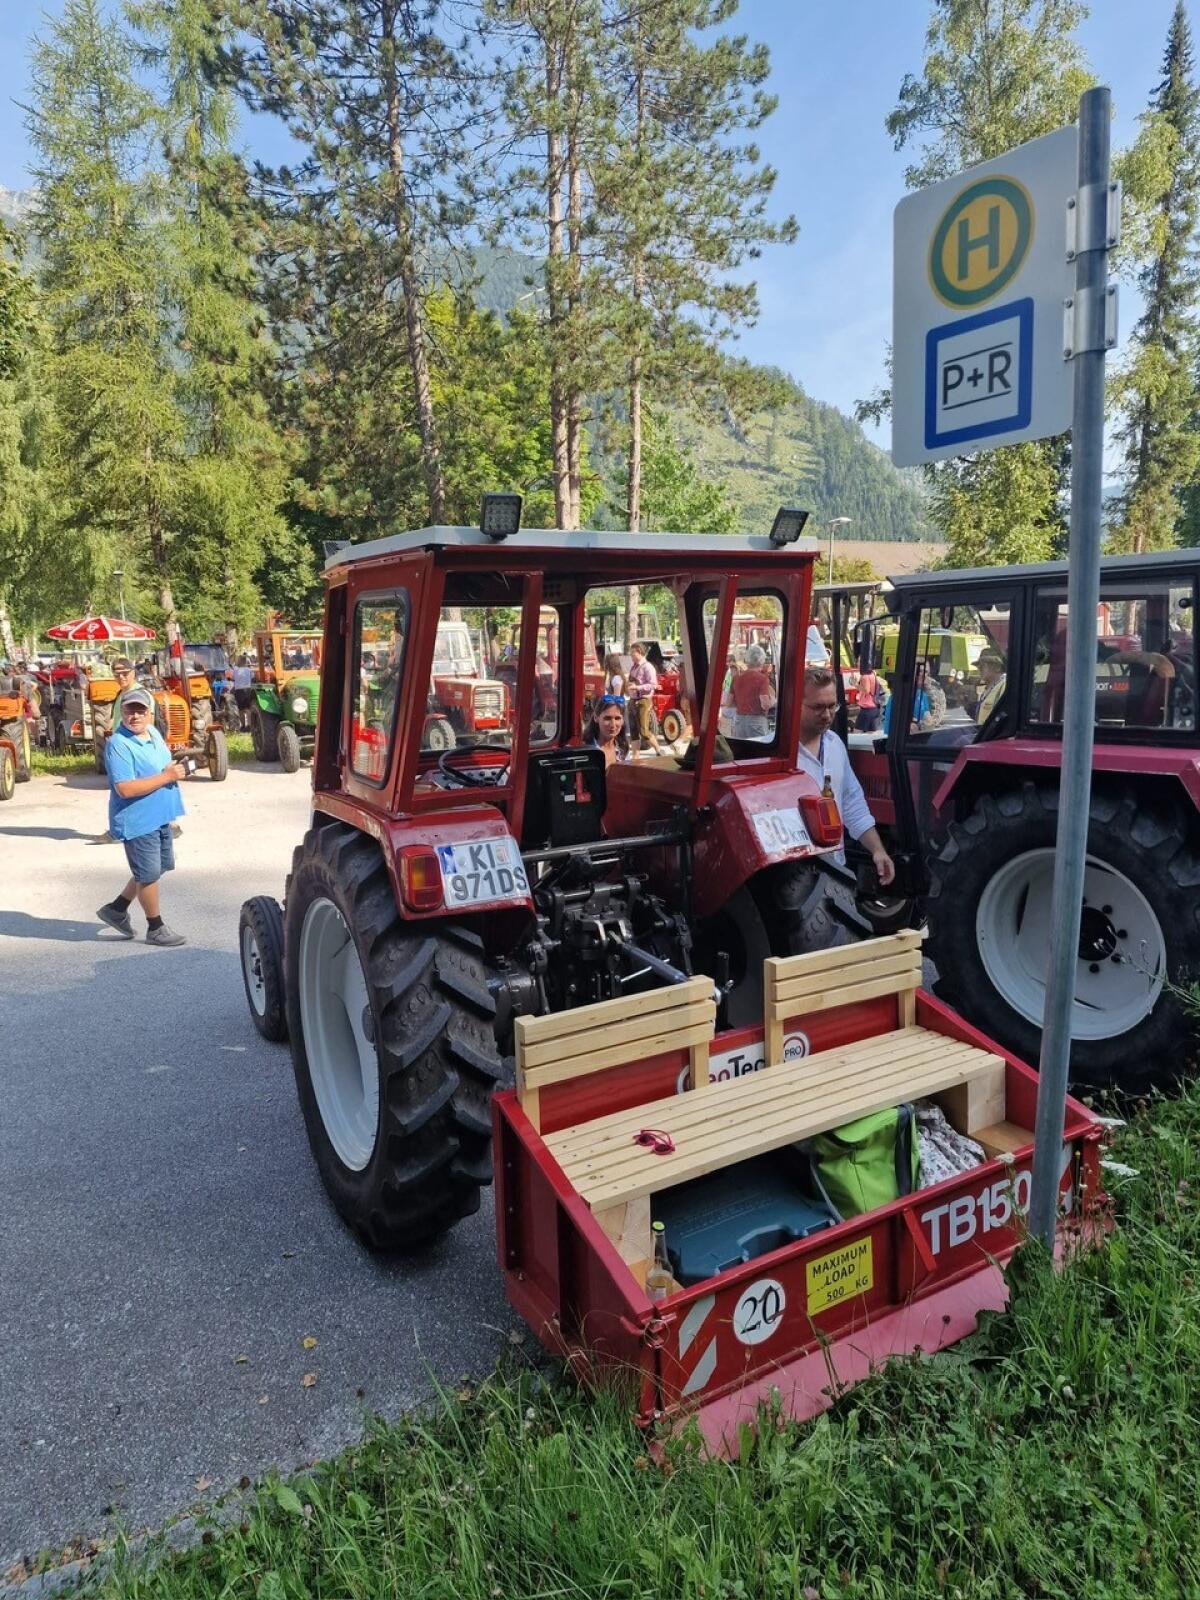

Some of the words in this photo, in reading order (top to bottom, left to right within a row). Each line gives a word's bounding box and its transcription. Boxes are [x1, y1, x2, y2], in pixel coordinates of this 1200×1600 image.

[957, 205, 1000, 282] H
[942, 351, 1012, 405] P+R
[469, 843, 496, 871] KI
[451, 866, 527, 901] 971DS
[784, 1045, 801, 1059] PRO
[921, 1170, 1032, 1256] TB150
[812, 1244, 867, 1278] MAXIMUM
[824, 1263, 856, 1287] LOAD
[826, 1285, 845, 1301] 500
[855, 1275, 868, 1289] KG
[740, 1285, 780, 1335] 20
